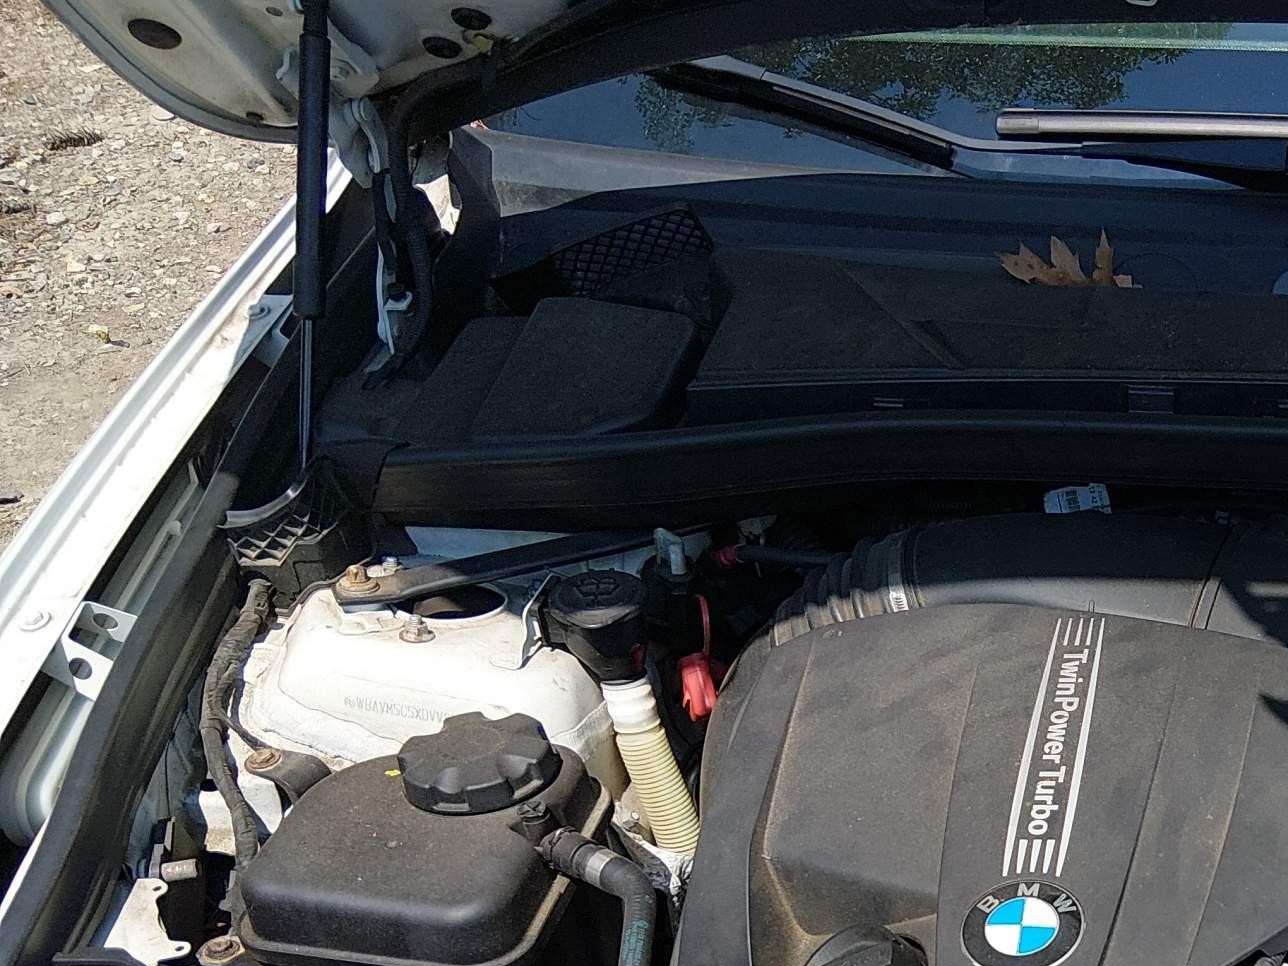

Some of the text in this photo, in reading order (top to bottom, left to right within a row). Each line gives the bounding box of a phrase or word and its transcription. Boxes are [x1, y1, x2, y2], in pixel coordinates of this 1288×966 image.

[1028, 648, 1089, 835] TwinPower Turbo
[976, 883, 1077, 913] BMW
